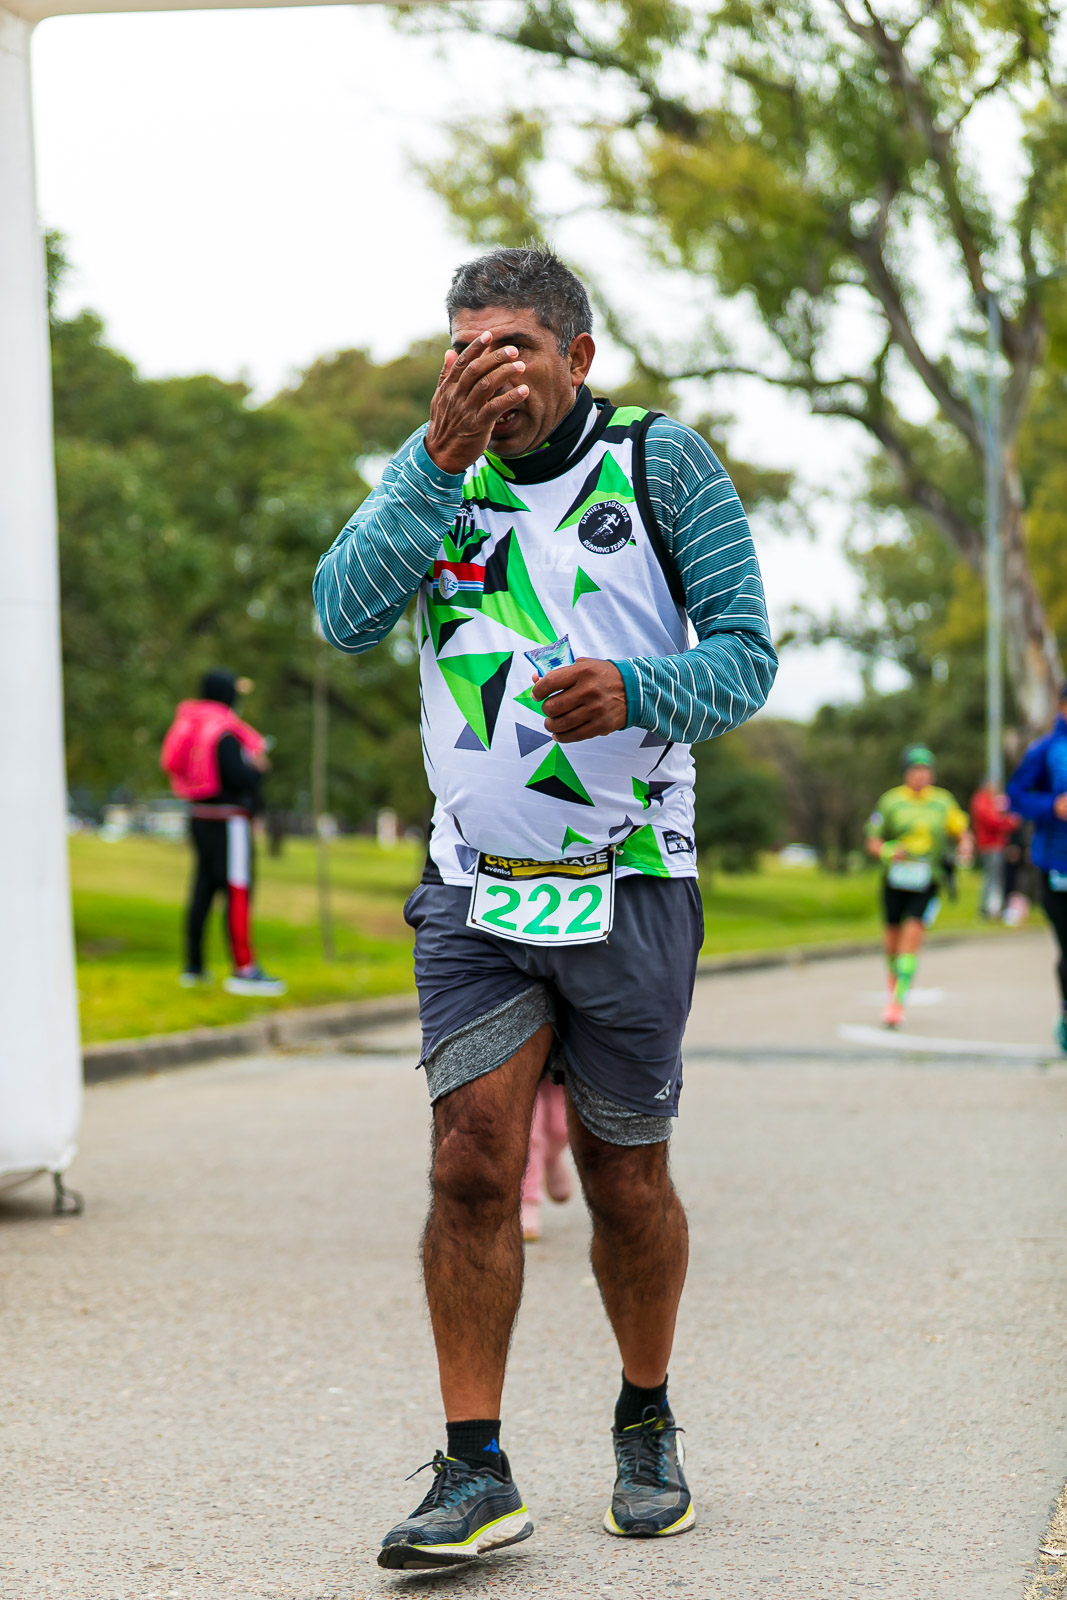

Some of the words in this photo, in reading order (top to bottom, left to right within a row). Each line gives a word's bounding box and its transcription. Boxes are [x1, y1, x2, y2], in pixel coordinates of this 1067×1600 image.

[580, 504, 602, 525] DANIEL
[603, 501, 630, 523] TABORDA
[582, 539, 610, 553] RUNNING
[609, 537, 627, 552] TEAM
[484, 865, 511, 876] eventos
[481, 883, 603, 935] 222
